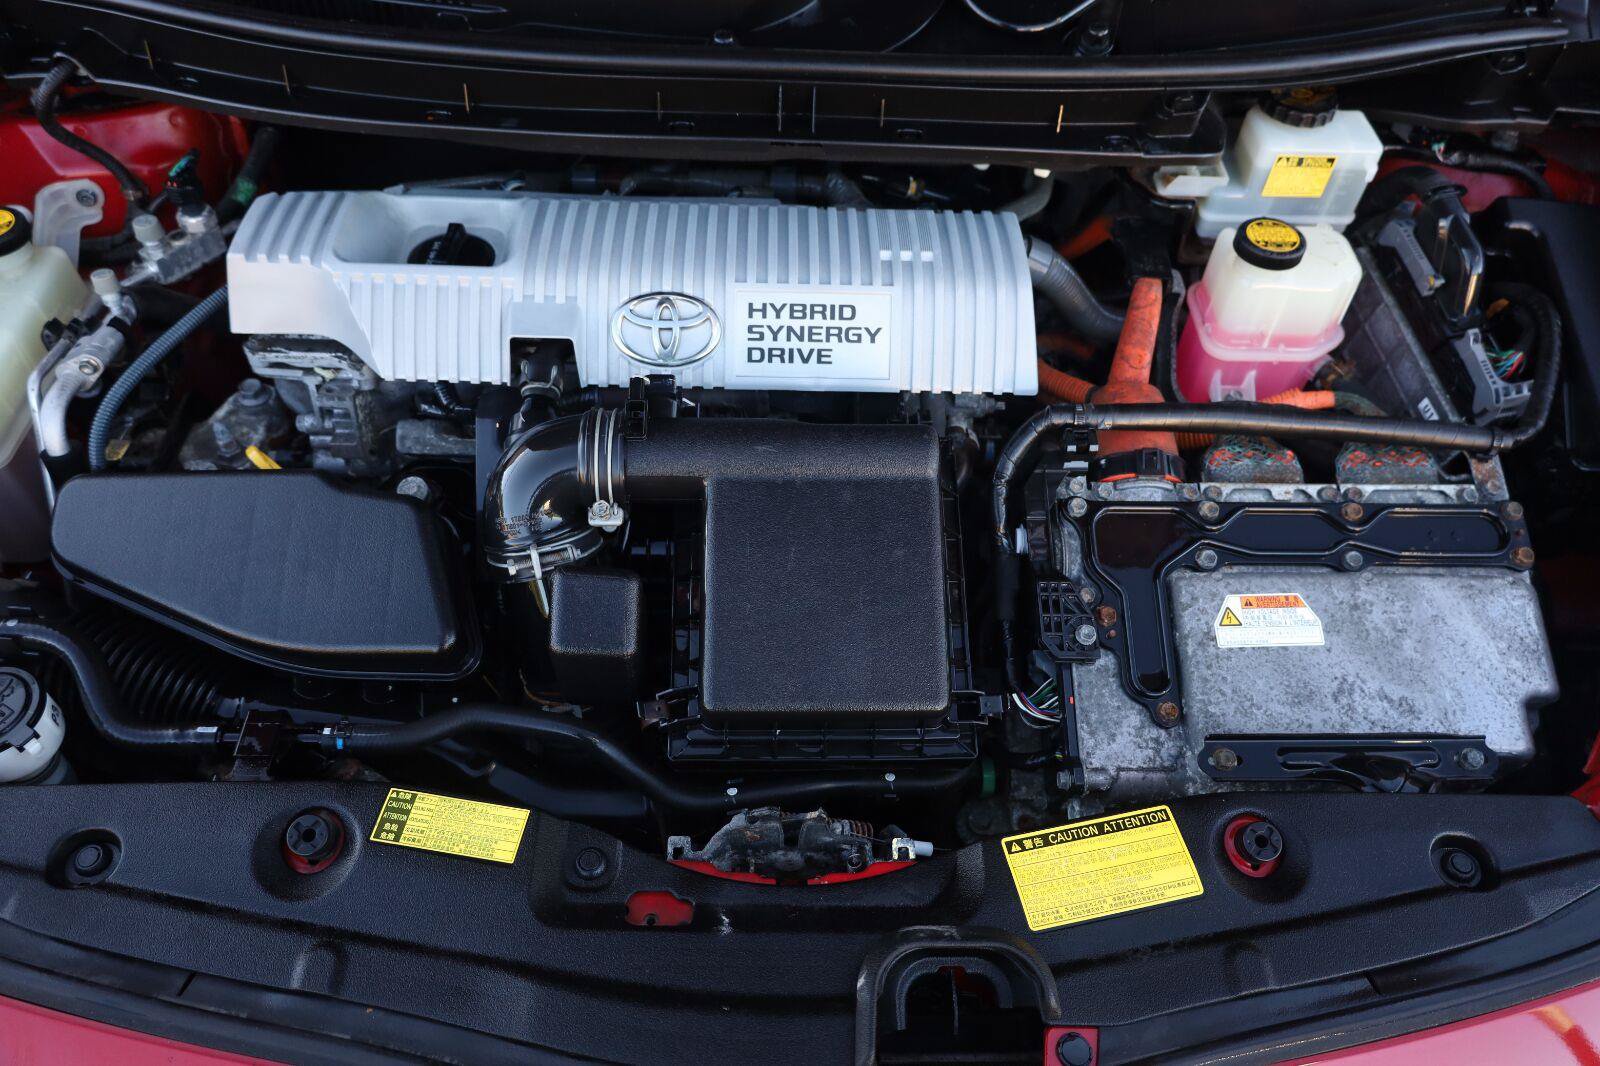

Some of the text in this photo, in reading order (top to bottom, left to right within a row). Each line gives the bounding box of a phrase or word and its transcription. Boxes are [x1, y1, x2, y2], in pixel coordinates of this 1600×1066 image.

[748, 302, 857, 321] HYBRID
[747, 325, 882, 344] SYNERGY
[747, 347, 833, 365] DRIVE
[388, 801, 413, 810] CAUTION
[383, 812, 408, 821] ATTENTION
[1022, 810, 1167, 850] 警告 CAUTION ATTENTION
